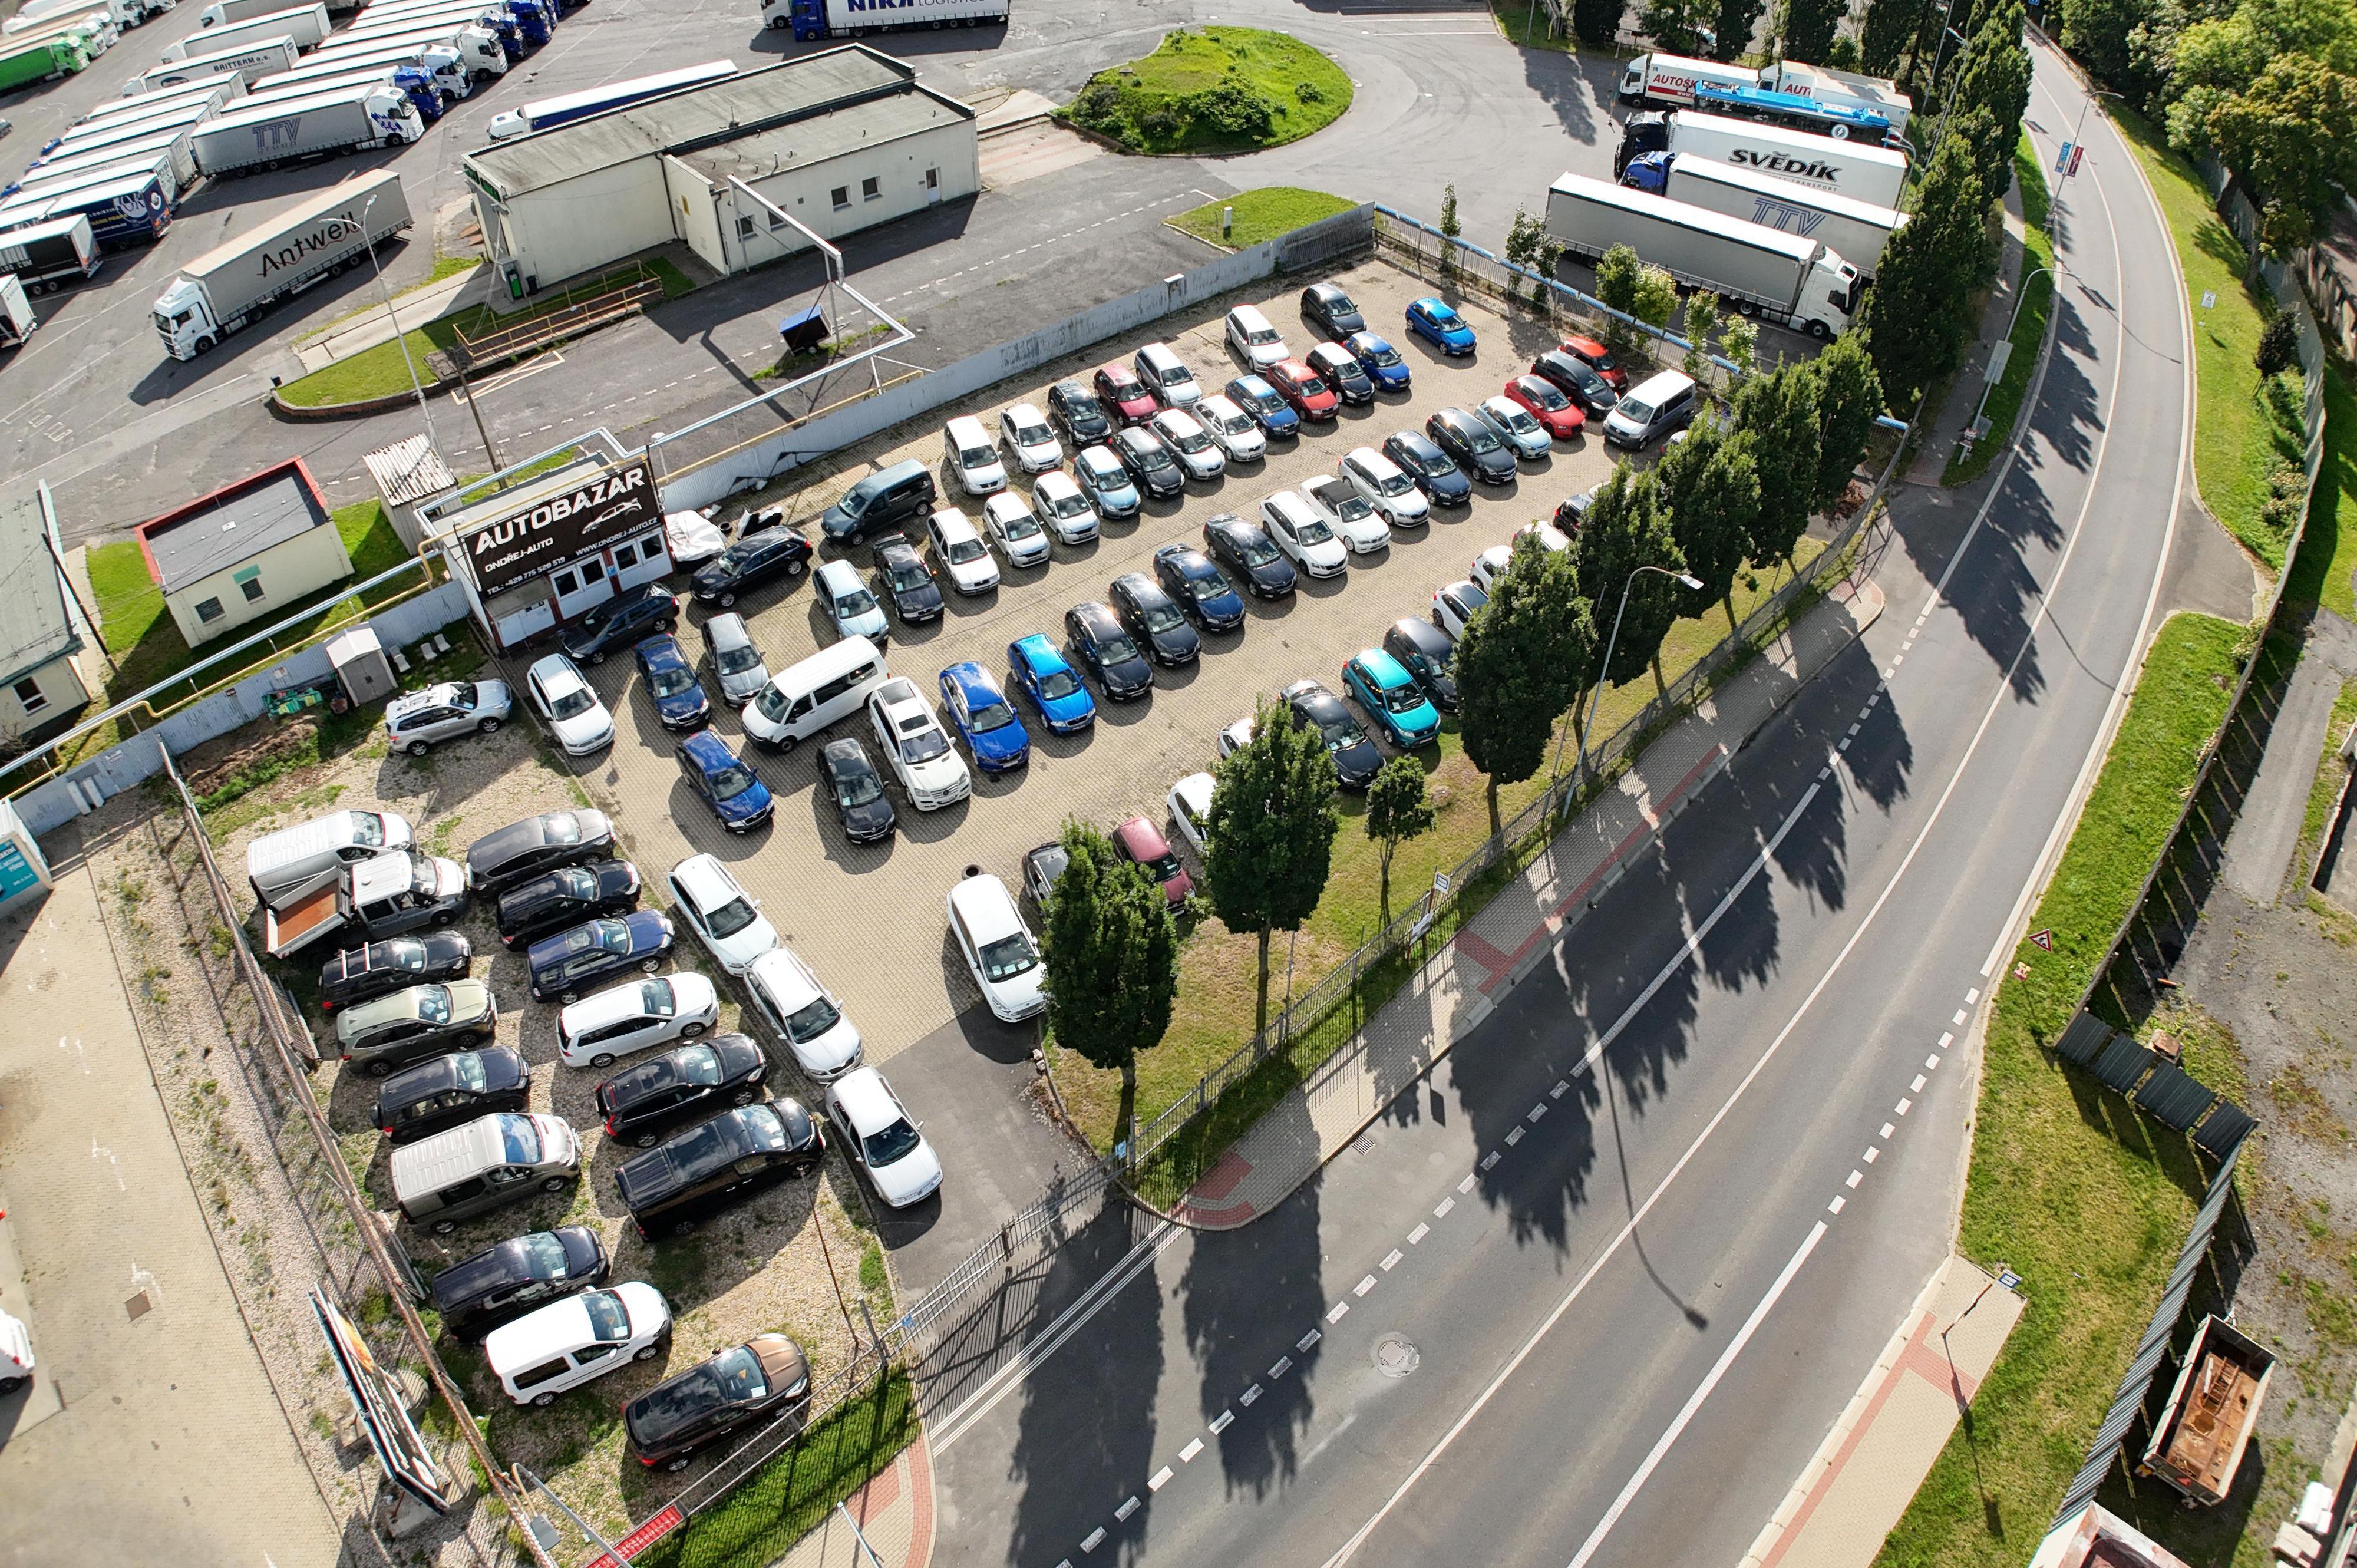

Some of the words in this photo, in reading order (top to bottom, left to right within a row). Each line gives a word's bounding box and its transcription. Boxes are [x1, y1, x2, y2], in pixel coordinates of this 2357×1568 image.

[213, 57, 255, 72] BRITTERM
[1784, 84, 1811, 95] AUT
[252, 117, 301, 148] TTV
[1728, 149, 1842, 183] SVĚDÍK
[1751, 197, 1826, 237] TTV
[262, 211, 357, 278] Antwell
[476, 468, 646, 556] AUTOBAZAR
[523, 569, 537, 579] 775
